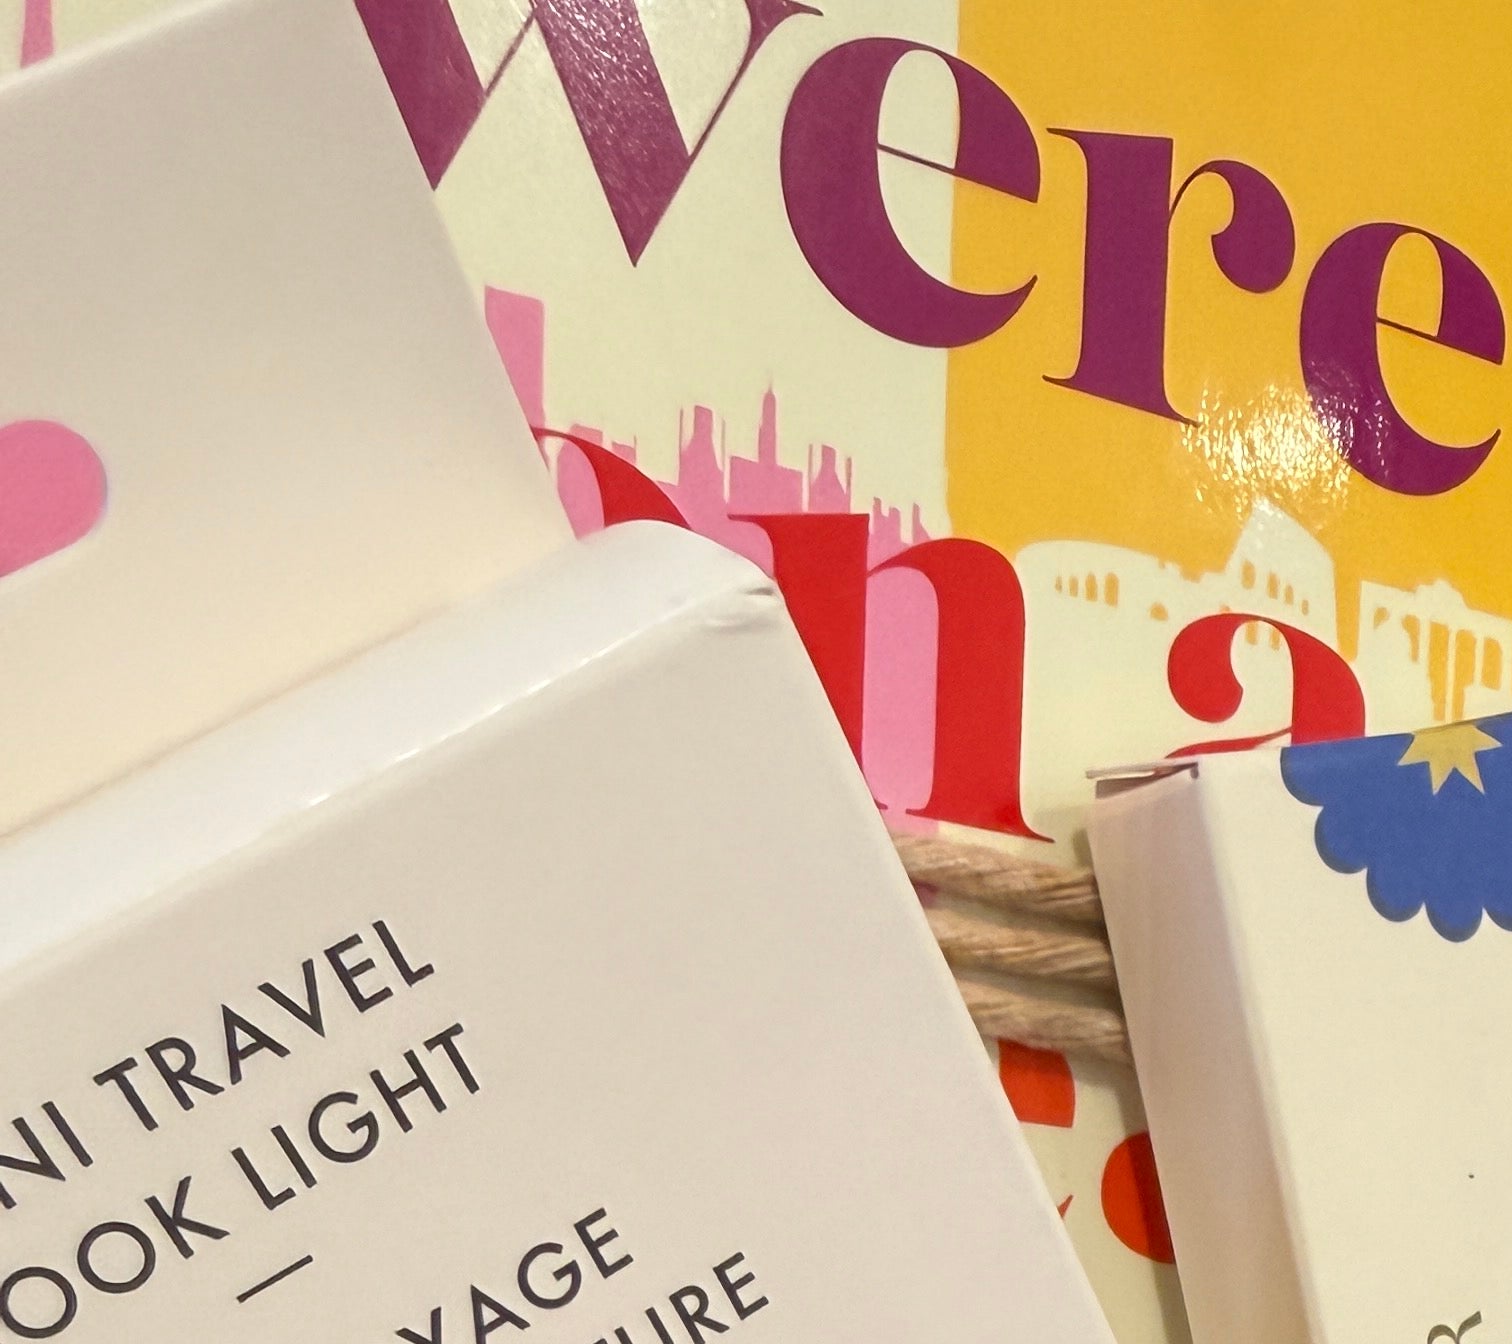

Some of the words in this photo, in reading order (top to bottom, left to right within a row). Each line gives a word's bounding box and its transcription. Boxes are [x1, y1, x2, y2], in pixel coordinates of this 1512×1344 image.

[354, 0, 1506, 497] Were
[93, 919, 435, 1132] TRAVEL
[231, 1022, 483, 1211] LIGHT
